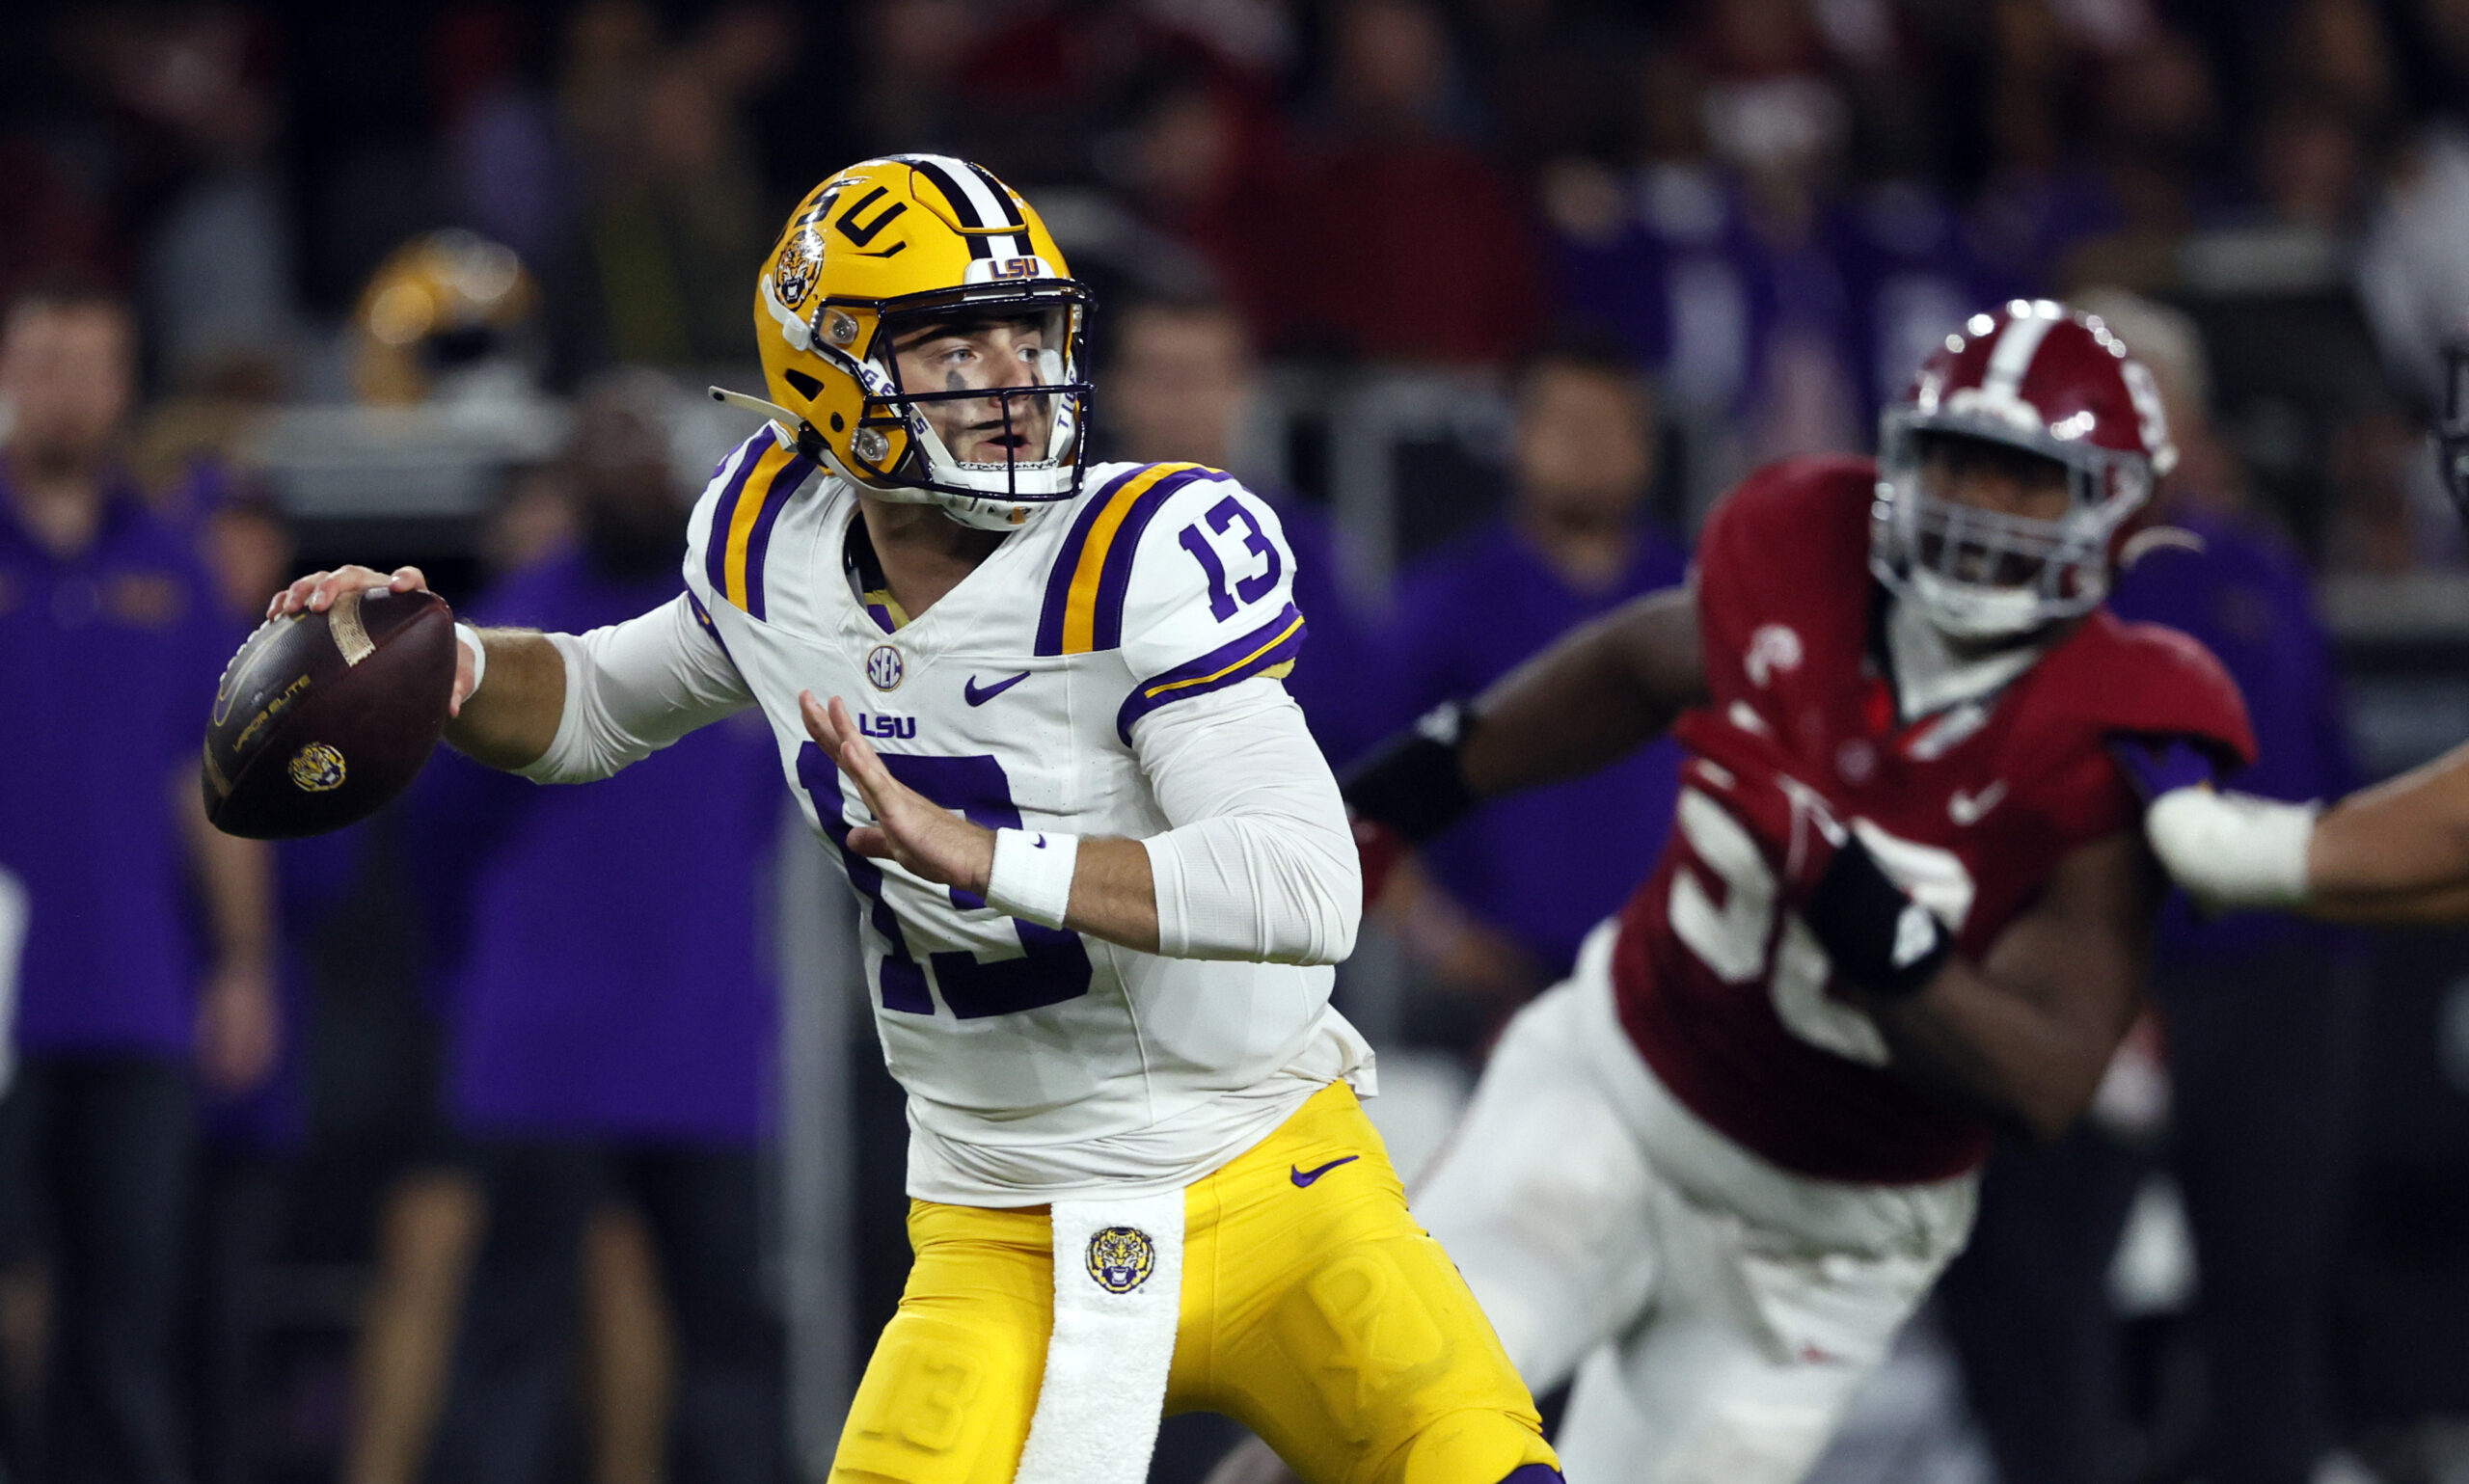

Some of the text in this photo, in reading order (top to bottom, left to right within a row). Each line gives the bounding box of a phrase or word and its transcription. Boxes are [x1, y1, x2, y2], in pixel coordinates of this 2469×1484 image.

[988, 257, 1040, 281] LSU
[1179, 495, 1281, 623] 13
[868, 646, 902, 689] SEC
[858, 713, 916, 740] LSU
[796, 741, 1094, 1019] 13
